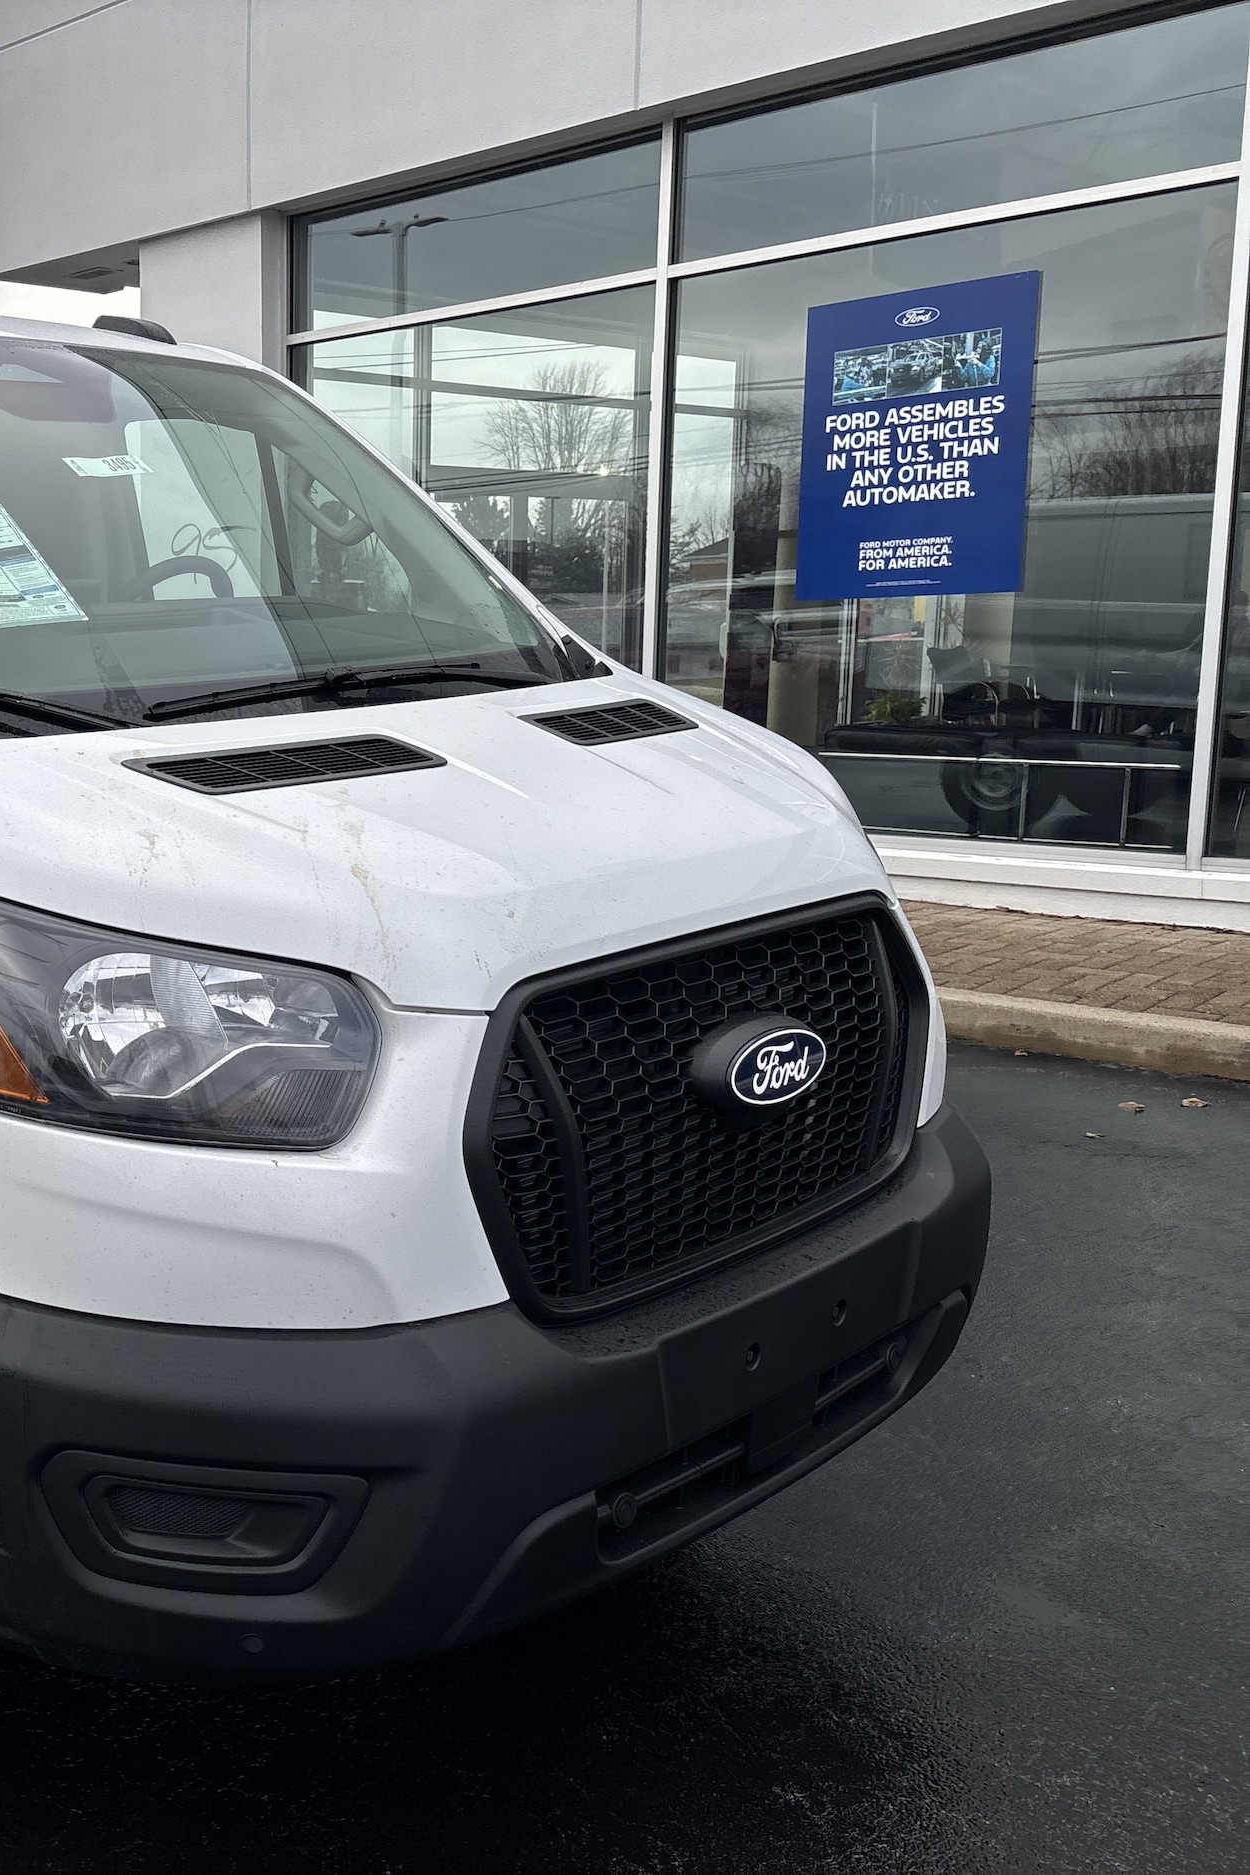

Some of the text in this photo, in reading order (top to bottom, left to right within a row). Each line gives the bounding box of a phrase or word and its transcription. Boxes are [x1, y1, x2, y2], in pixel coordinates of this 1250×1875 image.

[902, 309, 932, 325] Ford
[825, 395, 1005, 433] FORD ASSEMBLES
[833, 417, 994, 451] MORE VEHICLES
[102, 457, 136, 472] 3495
[826, 436, 999, 471] IN THE U.S. THAN
[850, 460, 969, 488] ANY OTHER
[842, 480, 976, 508] AUTOMAKER.
[859, 536, 954, 550] FORD MOTOR COMPANY.
[859, 544, 953, 560] FROM AMERICA.
[858, 555, 953, 571] FOR AMERICA.
[752, 1041, 810, 1095] Ford
